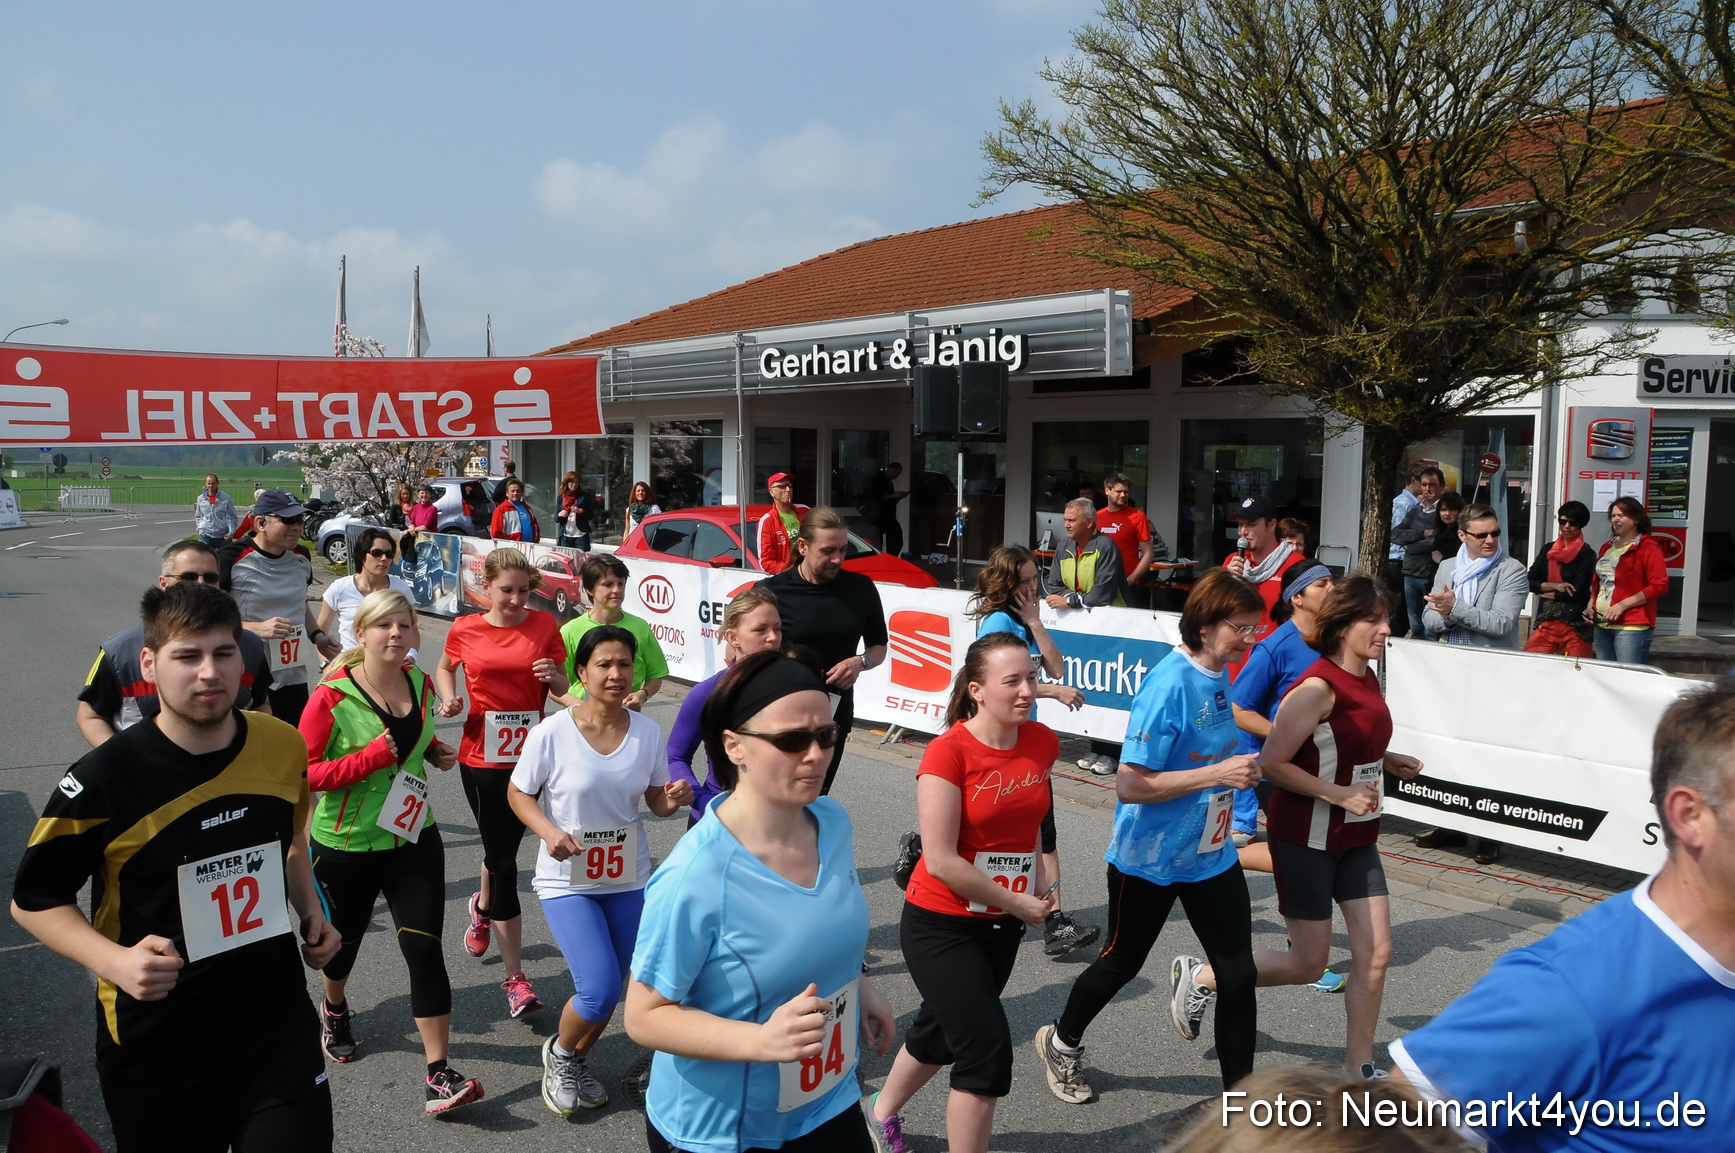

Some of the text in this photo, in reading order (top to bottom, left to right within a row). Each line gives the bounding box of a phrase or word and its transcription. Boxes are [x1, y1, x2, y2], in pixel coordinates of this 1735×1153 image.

[760, 328, 1022, 378] Gerhart & Jänig
[1578, 470, 1641, 480] SEAT
[645, 584, 670, 606] KIA
[279, 638, 301, 665] 97
[885, 695, 946, 718] SEAT
[497, 726, 529, 757] 22
[402, 781, 423, 796] WERBUNG
[403, 775, 426, 791] MEYER
[393, 794, 425, 833] 21
[1398, 780, 1472, 810] Leistungen,
[1475, 798, 1499, 814] die
[1503, 803, 1584, 831] verbinden
[201, 807, 249, 830] saller
[584, 830, 615, 839] MEYER
[1642, 822, 1661, 846] S
[196, 854, 243, 877] MEYER
[586, 845, 624, 880] 95
[987, 856, 1021, 865] MEYER
[987, 864, 1020, 872] WERBUNG
[196, 866, 244, 884] WERBUNG
[210, 876, 263, 939] 12
[800, 1020, 844, 1093] 84
